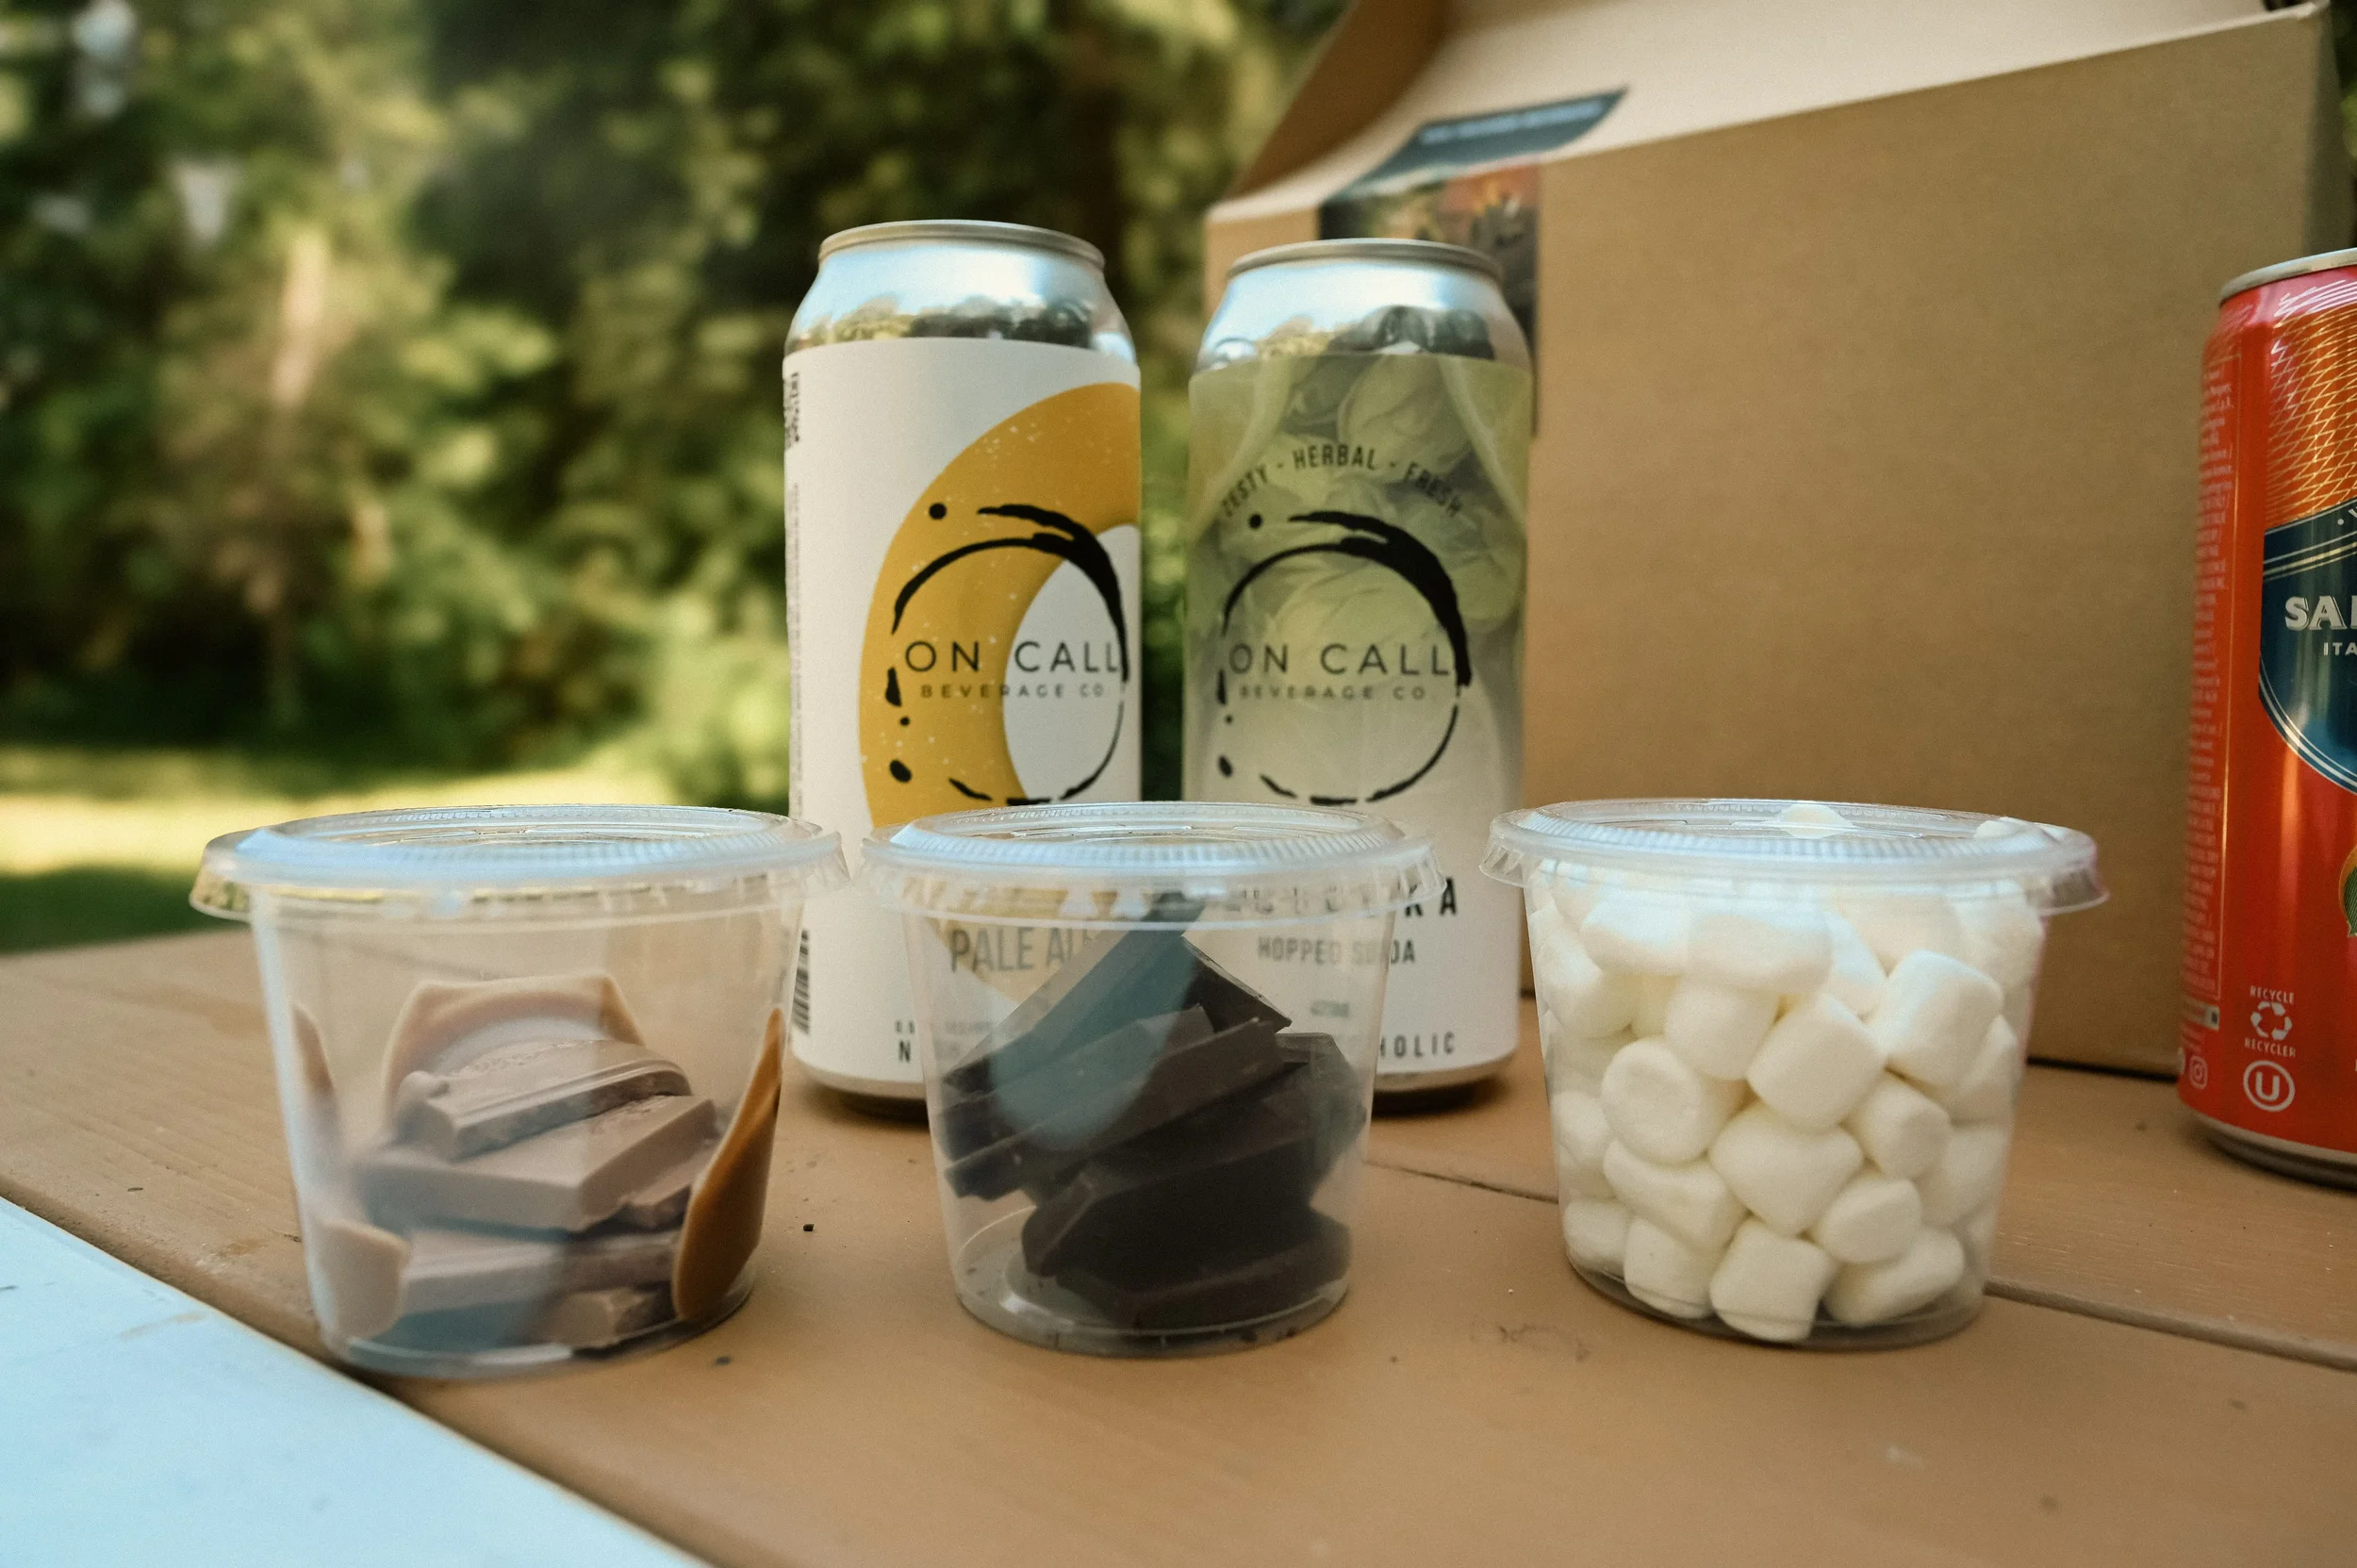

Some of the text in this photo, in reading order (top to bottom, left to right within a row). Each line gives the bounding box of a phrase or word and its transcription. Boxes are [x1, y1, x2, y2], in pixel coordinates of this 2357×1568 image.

[1221, 444, 1462, 518] ZESTY HERBAL FRESH
[2285, 595, 2357, 631] SA
[905, 640, 1119, 673] ON CALL
[1229, 642, 1450, 675] ON CALL
[921, 684, 1054, 698] BEVERAGE
[1239, 685, 1375, 701] BEVERAGE
[951, 926, 1035, 972] PALE
[1258, 935, 1340, 964] HOPPED
[2250, 985, 2294, 1004] RECYCLE
[2244, 1037, 2296, 1058] RECYCLER
